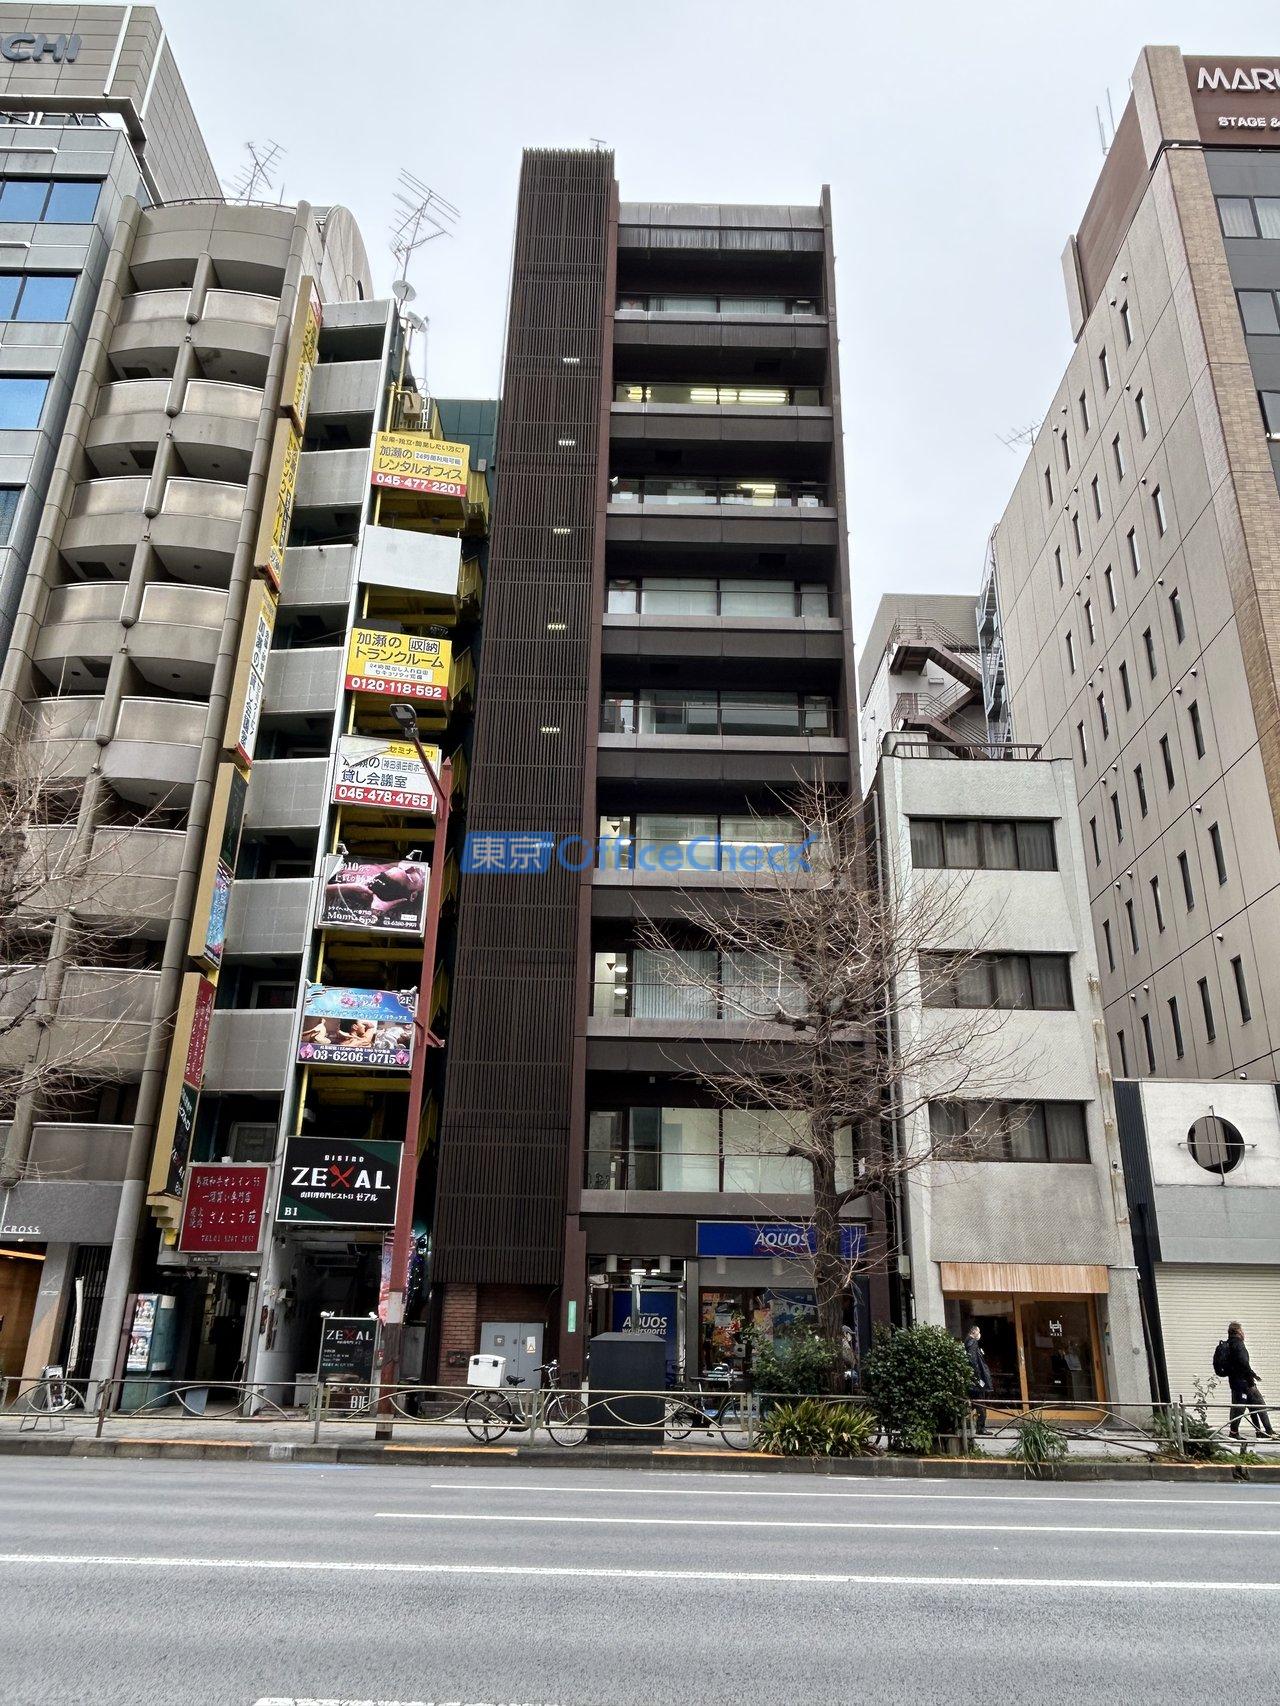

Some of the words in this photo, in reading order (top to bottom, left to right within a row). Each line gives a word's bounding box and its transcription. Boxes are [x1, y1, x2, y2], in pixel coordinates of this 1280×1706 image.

[0, 33, 82, 63] CHI
[1218, 116, 1267, 128] STAGE
[379, 457, 462, 481] レンタルオフィス
[356, 632, 402, 648] 加瀬の
[355, 646, 445, 669] トランクルーム
[341, 768, 408, 789] 貸し会議室
[312, 1049, 397, 1065] 03-6206-0715
[324, 1154, 365, 1163] BISTRO
[291, 1164, 391, 1190] ZEXAL
[356, 1192, 379, 1202] ゼアル
[284, 1207, 298, 1216] B1
[3, 1225, 40, 1234] CROSS
[755, 1232, 808, 1246] AQUOS
[622, 1316, 668, 1328] AUOS
